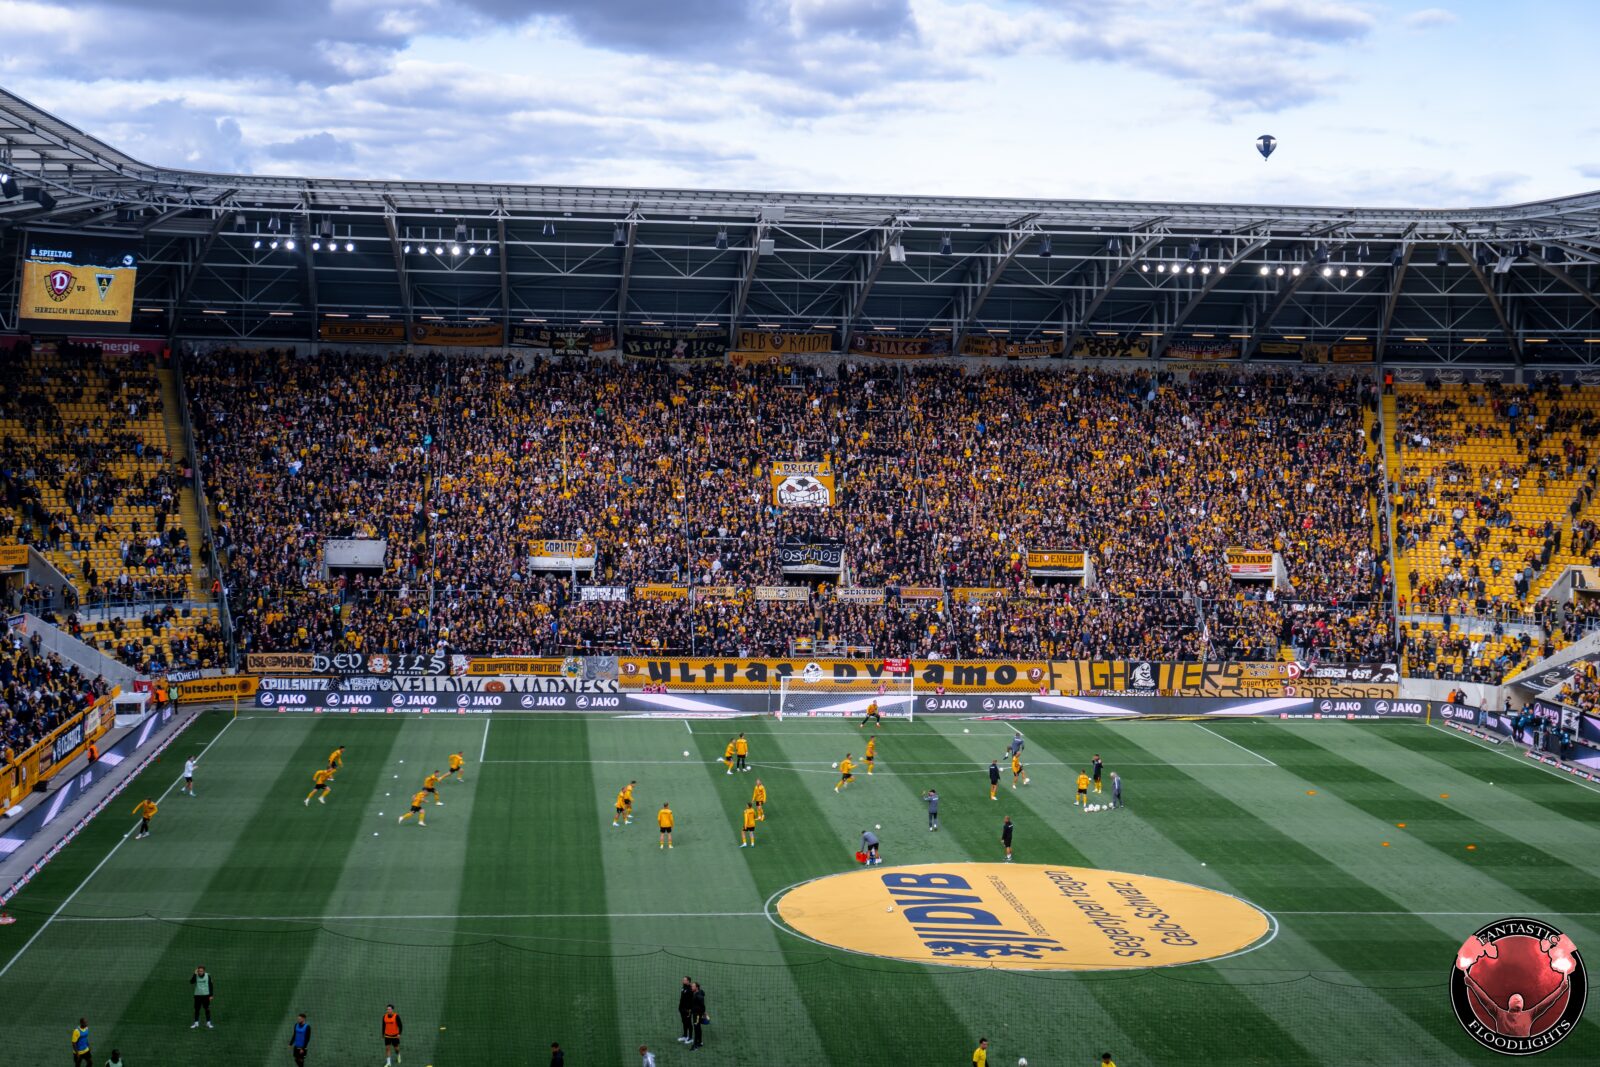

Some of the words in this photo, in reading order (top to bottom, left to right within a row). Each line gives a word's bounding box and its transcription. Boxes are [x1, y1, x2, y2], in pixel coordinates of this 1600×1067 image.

[39, 249, 72, 258] SPIELTAG
[34, 306, 67, 314] HERZLICH
[69, 308, 119, 316] WILLKOMMEN!
[1228, 555, 1272, 563] DYNAMO
[276, 694, 306, 704] JAKO
[342, 695, 372, 704] JAKO
[407, 695, 437, 705] JAKO
[472, 696, 502, 705] JAKO
[537, 697, 566, 706] JAKO
[591, 697, 619, 707] JAKO
[940, 699, 968, 709] JAKO
[997, 699, 1024, 709] JAKO
[1334, 702, 1361, 711] JAKO
[1391, 703, 1422, 714] JAKO
[1454, 707, 1474, 720] JAKO
[1044, 870, 1091, 898] tragen
[881, 872, 1002, 926] DVB
[1107, 880, 1198, 946] Gelb-Schwarz
[1073, 899, 1151, 958] Siegertypen
